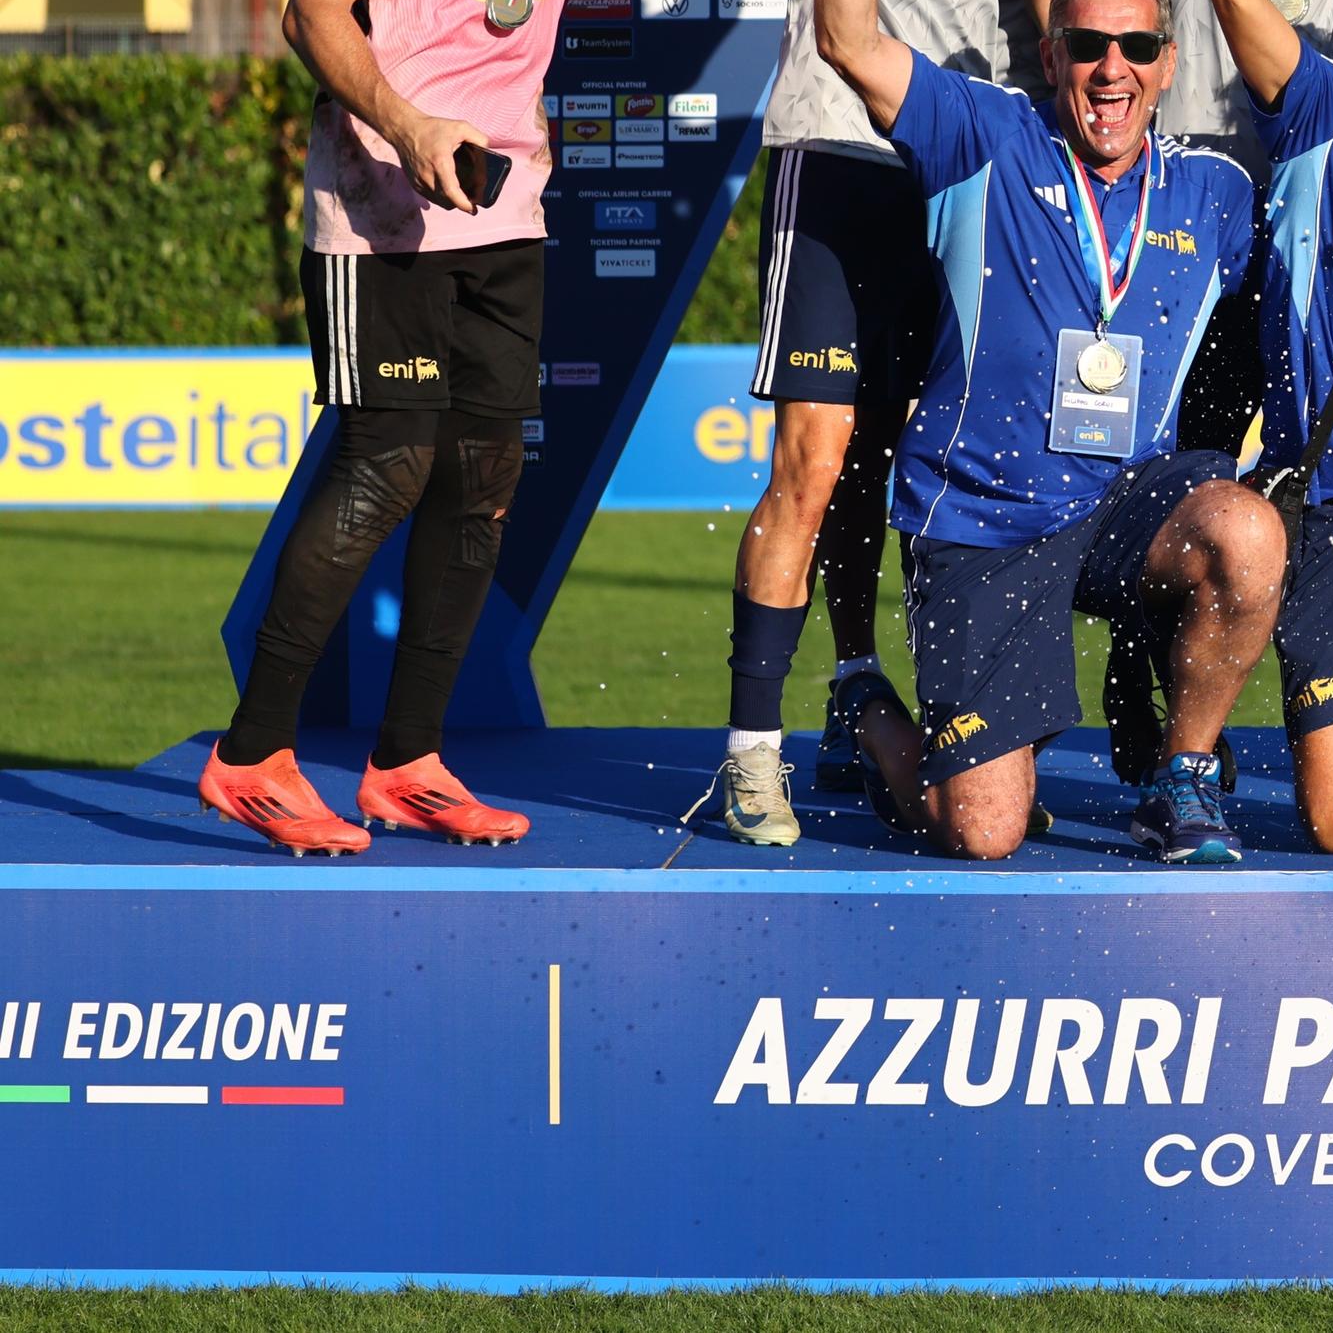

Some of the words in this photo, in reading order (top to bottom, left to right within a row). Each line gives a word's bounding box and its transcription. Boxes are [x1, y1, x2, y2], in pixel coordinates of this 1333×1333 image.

[582, 81, 614, 89] OFFICIAL
[616, 81, 647, 89] PARTNER
[578, 190, 611, 198] OFFICIAL
[612, 190, 640, 198] AIRLINE
[641, 190, 672, 198] CARRIER
[605, 206, 645, 218] ITA
[590, 238, 628, 246] TICKETING
[629, 238, 661, 246] PARTNER
[1145, 230, 1175, 251] eni
[600, 259, 651, 267] VIVATICKET
[789, 348, 826, 370] eni
[379, 359, 414, 380] eni
[62, 1002, 348, 1062] EDIZIONE
[712, 997, 1222, 1107] AZZURRI
